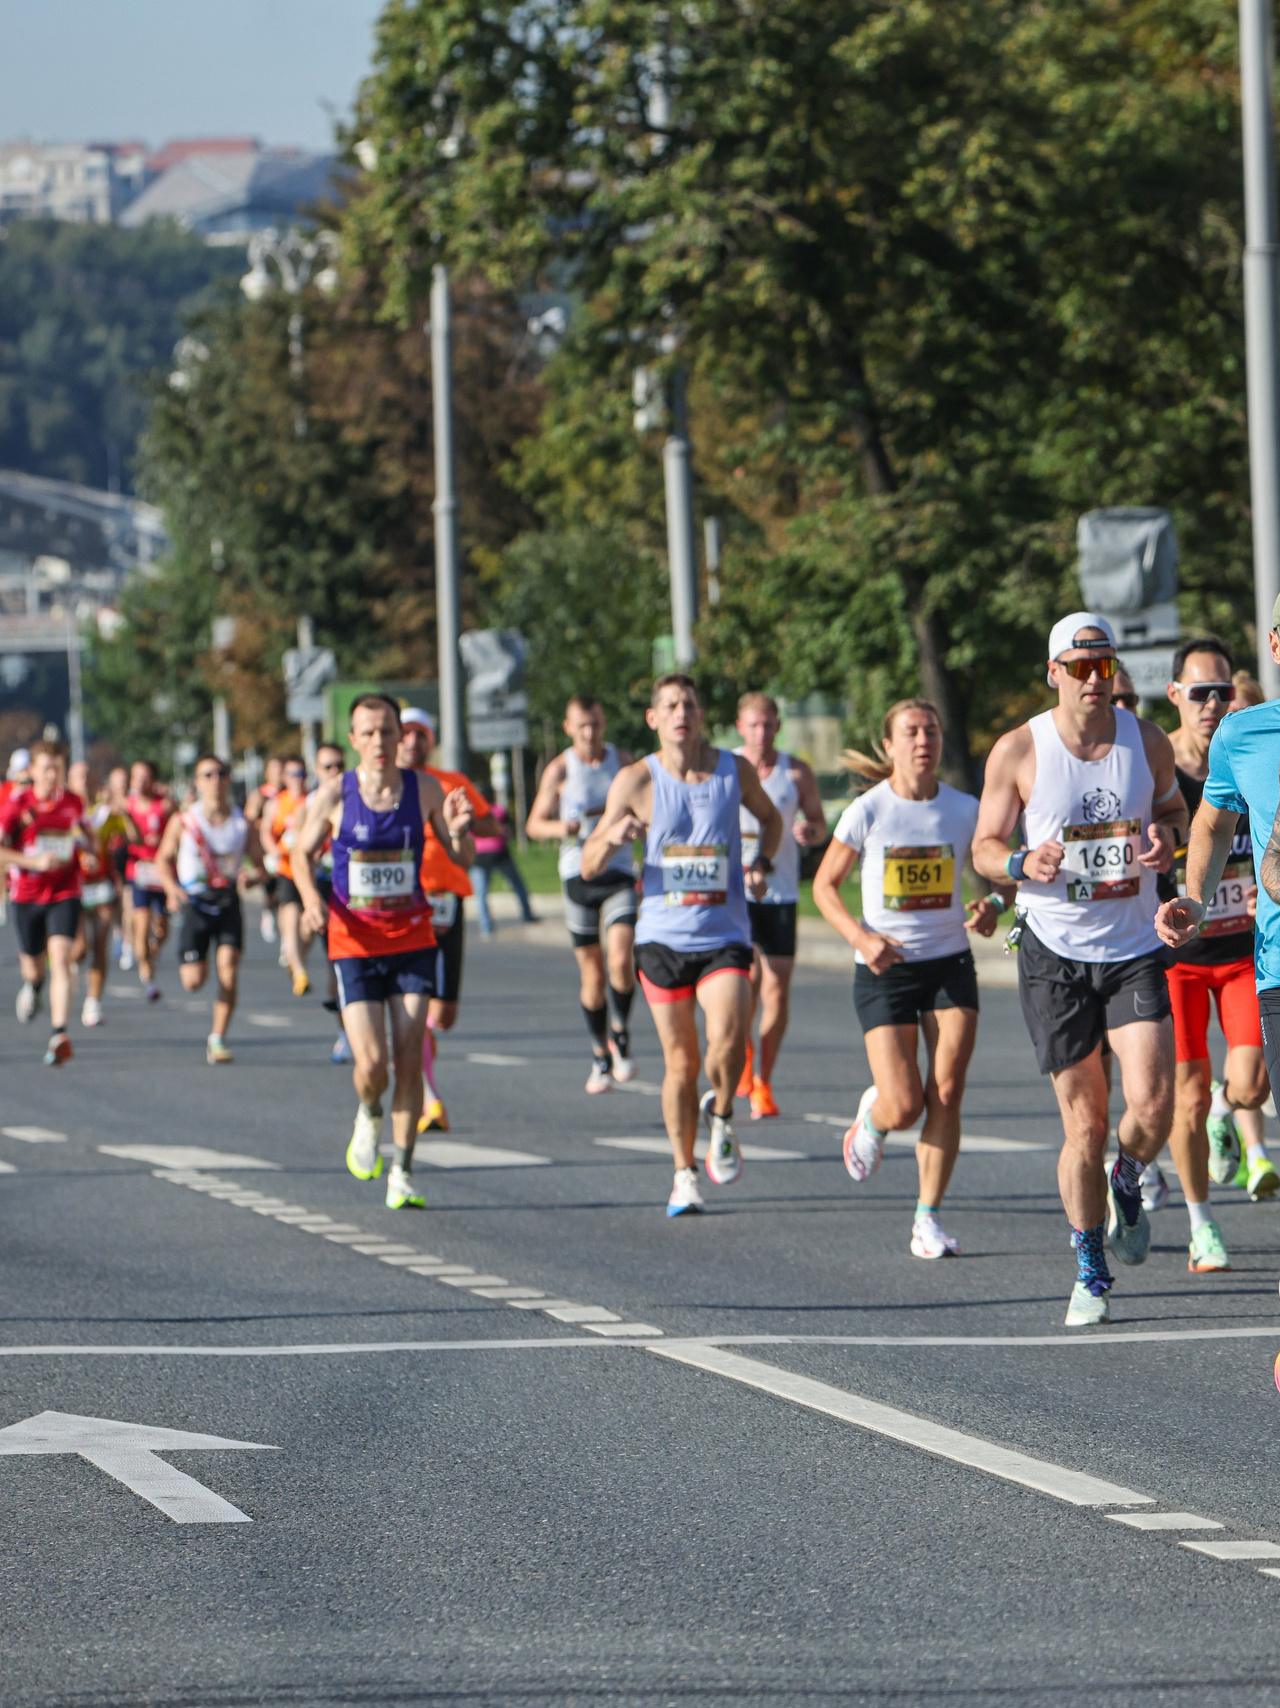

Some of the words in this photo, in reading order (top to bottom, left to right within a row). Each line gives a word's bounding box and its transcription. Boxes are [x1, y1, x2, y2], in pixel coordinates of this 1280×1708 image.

[1079, 843, 1133, 868] 1630
[360, 866, 406, 886] 5890
[895, 864, 942, 884] 1561
[1208, 883, 1243, 908] 13
